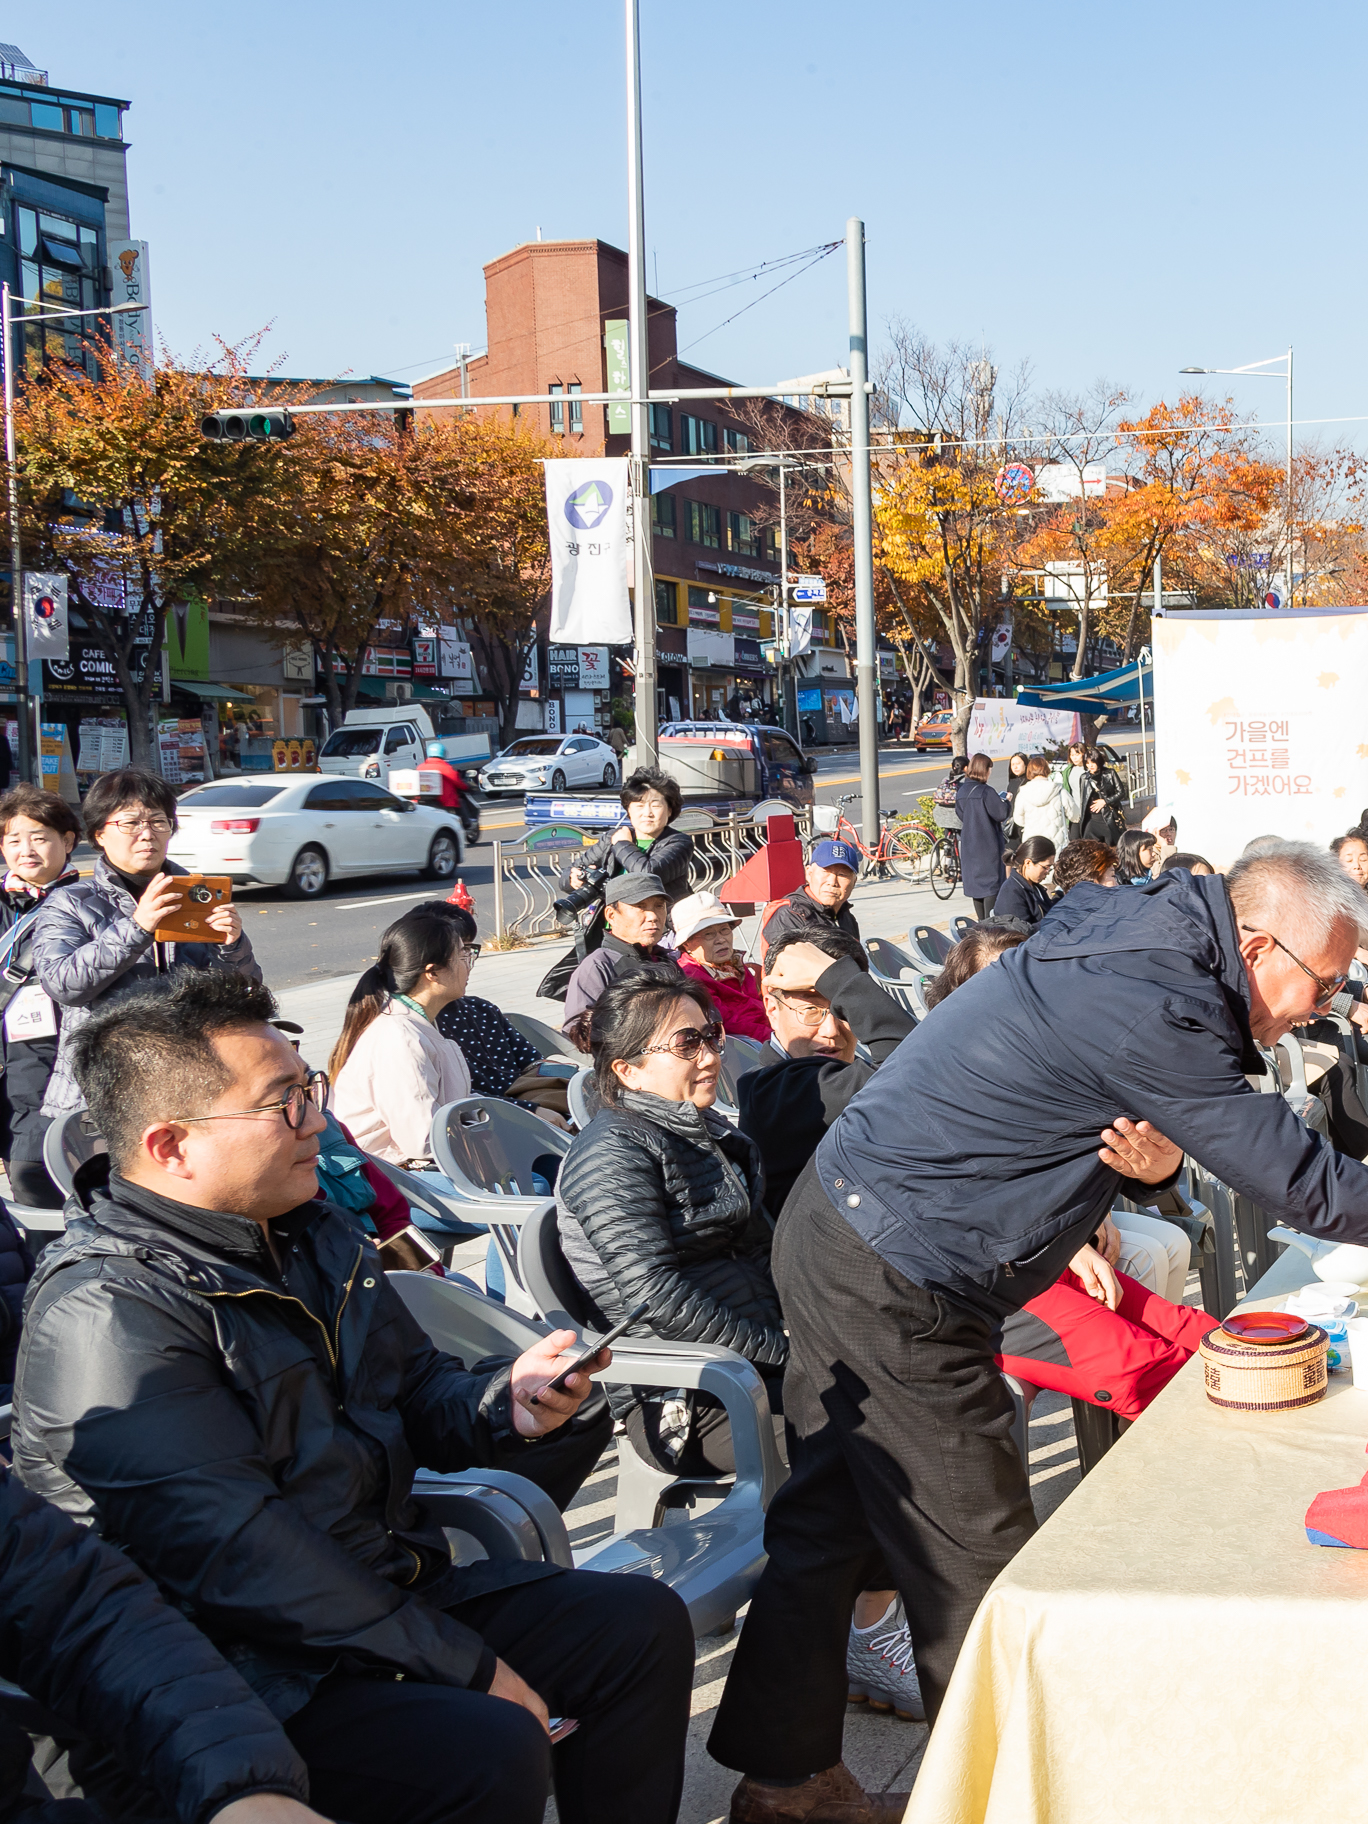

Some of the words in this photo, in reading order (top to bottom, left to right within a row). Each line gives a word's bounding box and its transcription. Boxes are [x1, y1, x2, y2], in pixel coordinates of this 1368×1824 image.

[82, 649, 106, 659] CAFE
[549, 650, 577, 661] HAIR
[581, 652, 601, 670] 꽃
[549, 664, 579, 673] BONO
[1225, 720, 1289, 743] 가을엔
[41, 757, 58, 765] TAKE
[1227, 748, 1290, 769] 건프를
[42, 765, 57, 773] OUT
[1228, 775, 1313, 796] 가겠어요
[17, 1011, 42, 1026] 스탭
